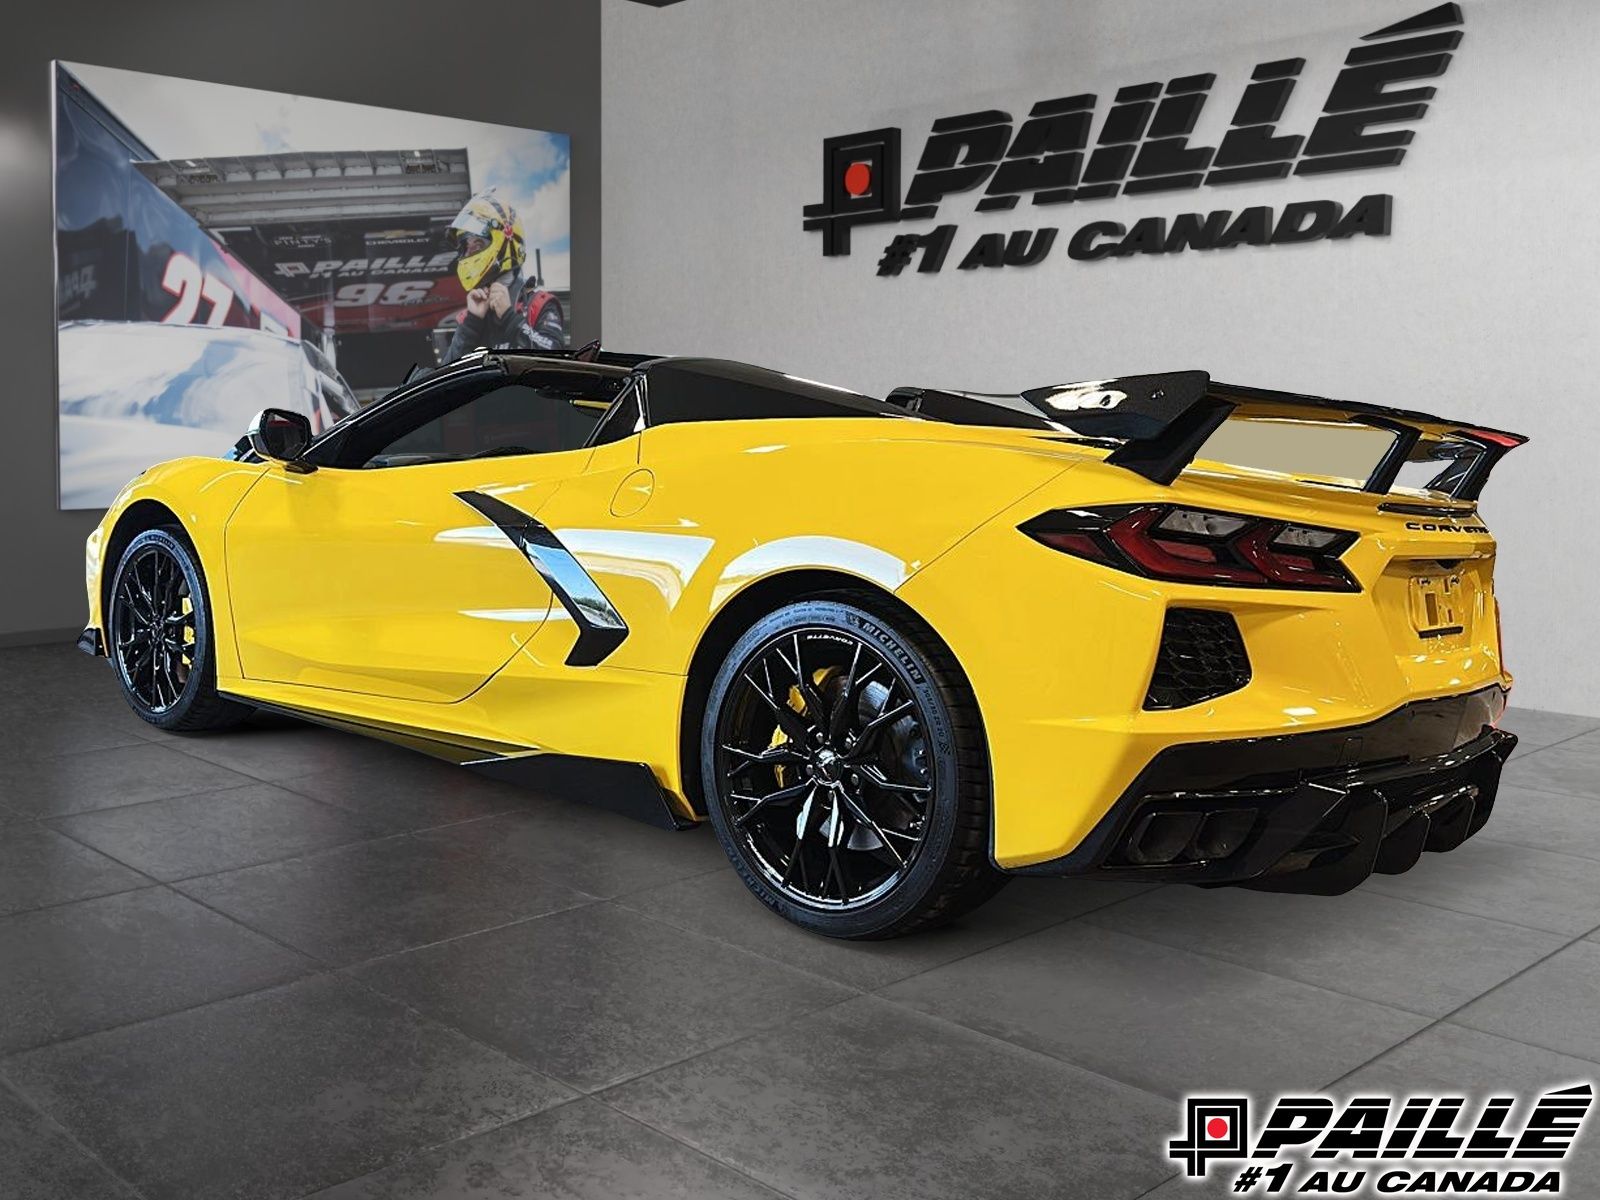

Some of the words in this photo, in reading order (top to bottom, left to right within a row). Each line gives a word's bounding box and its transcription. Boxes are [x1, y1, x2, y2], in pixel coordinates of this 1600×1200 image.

[900, 1, 1464, 219] PAILLÉ
[365, 237, 430, 246] CHEVROLET
[877, 223, 958, 277] #1
[957, 227, 1058, 270] AU
[1067, 193, 1393, 261] CANADA
[162, 252, 234, 328] 27
[333, 281, 435, 307] 96
[338, 270, 364, 278] AU
[370, 266, 448, 275] CANADA
[806, 634, 853, 645] CORVETTE
[862, 621, 923, 685] MICHELIN
